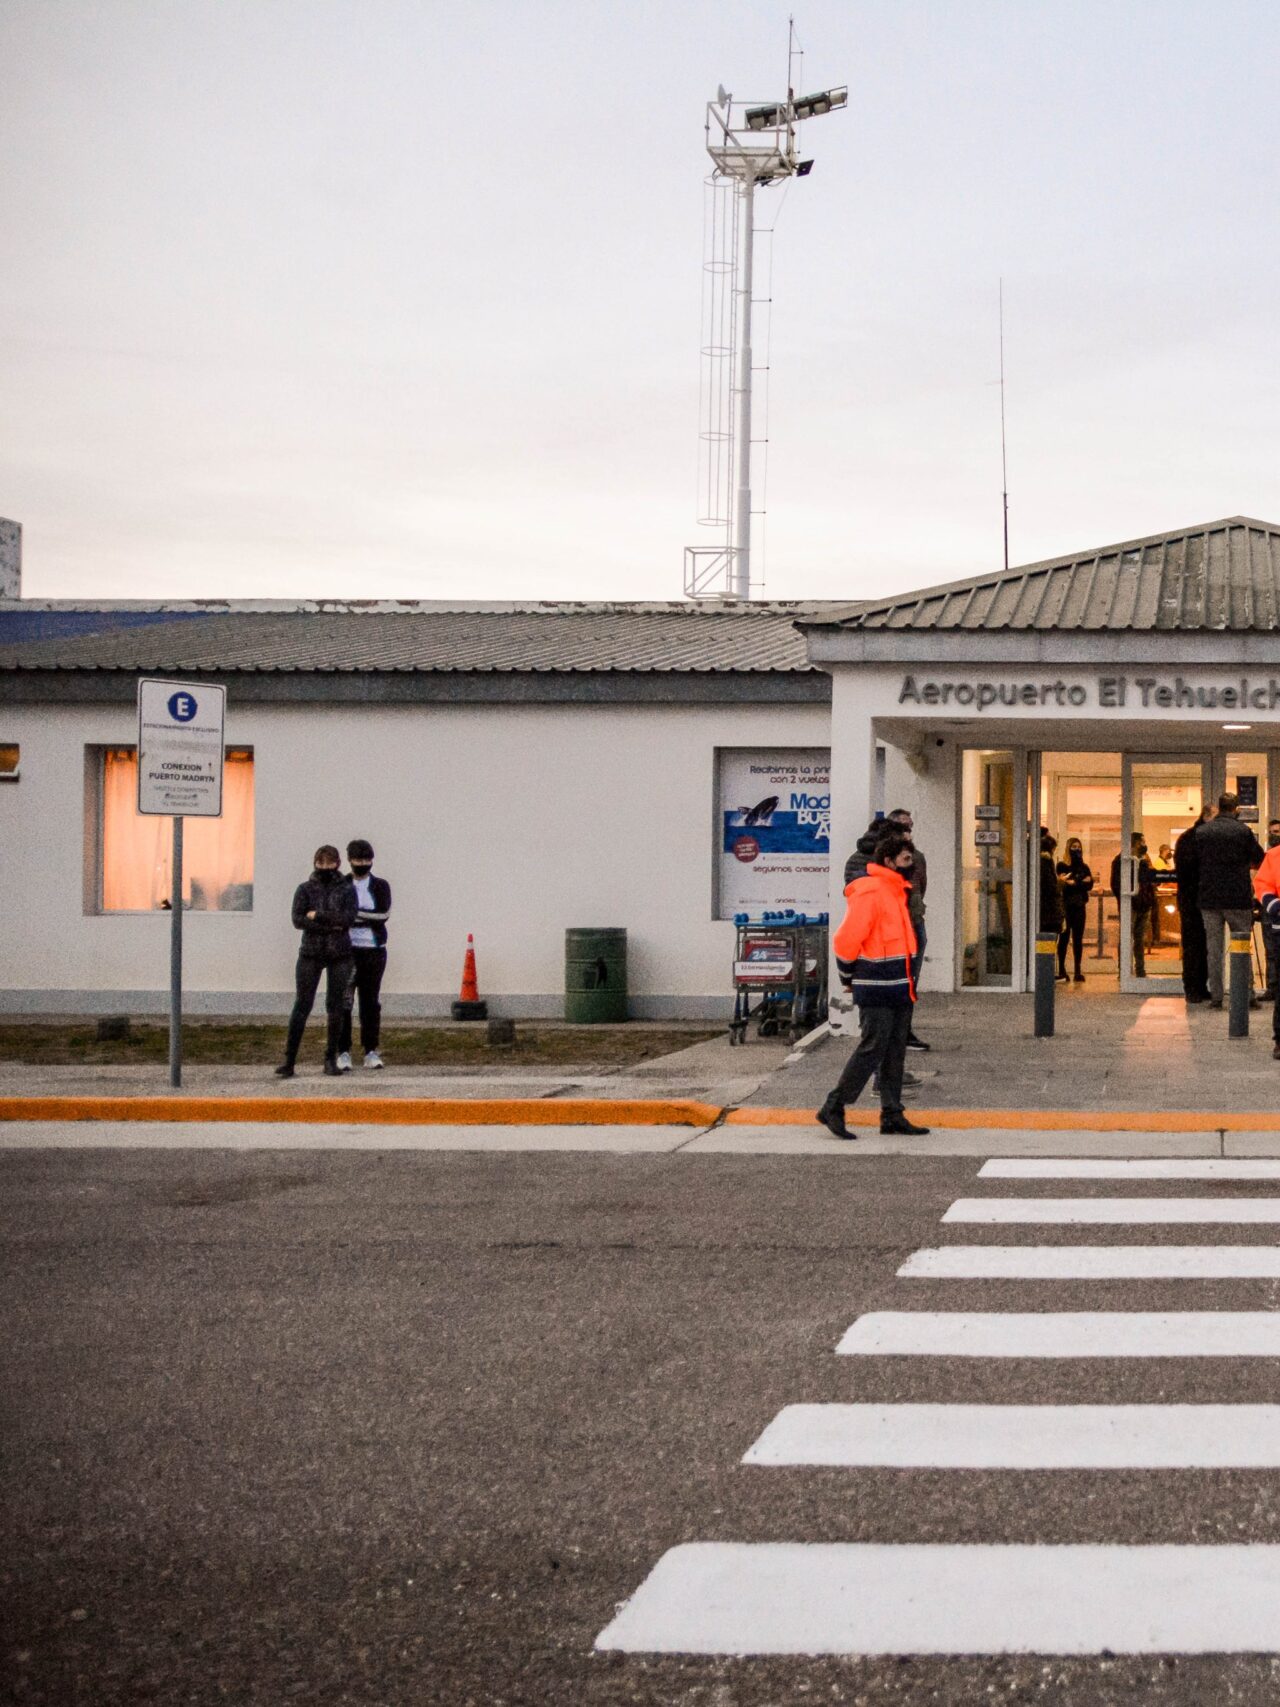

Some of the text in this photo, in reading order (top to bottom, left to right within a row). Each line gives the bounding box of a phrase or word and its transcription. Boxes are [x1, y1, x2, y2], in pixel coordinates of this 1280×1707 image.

[898, 675, 1088, 713] Aeropuerto
[1098, 676, 1126, 708] El
[177, 697, 190, 717] E
[161, 762, 202, 772] CONEXION
[749, 765, 798, 774] Recibimos
[800, 765, 811, 774] la
[149, 772, 215, 783] PUERTO MADRYN
[769, 775, 830, 784] con 2 vuelos
[752, 865, 793, 875] seguimos
